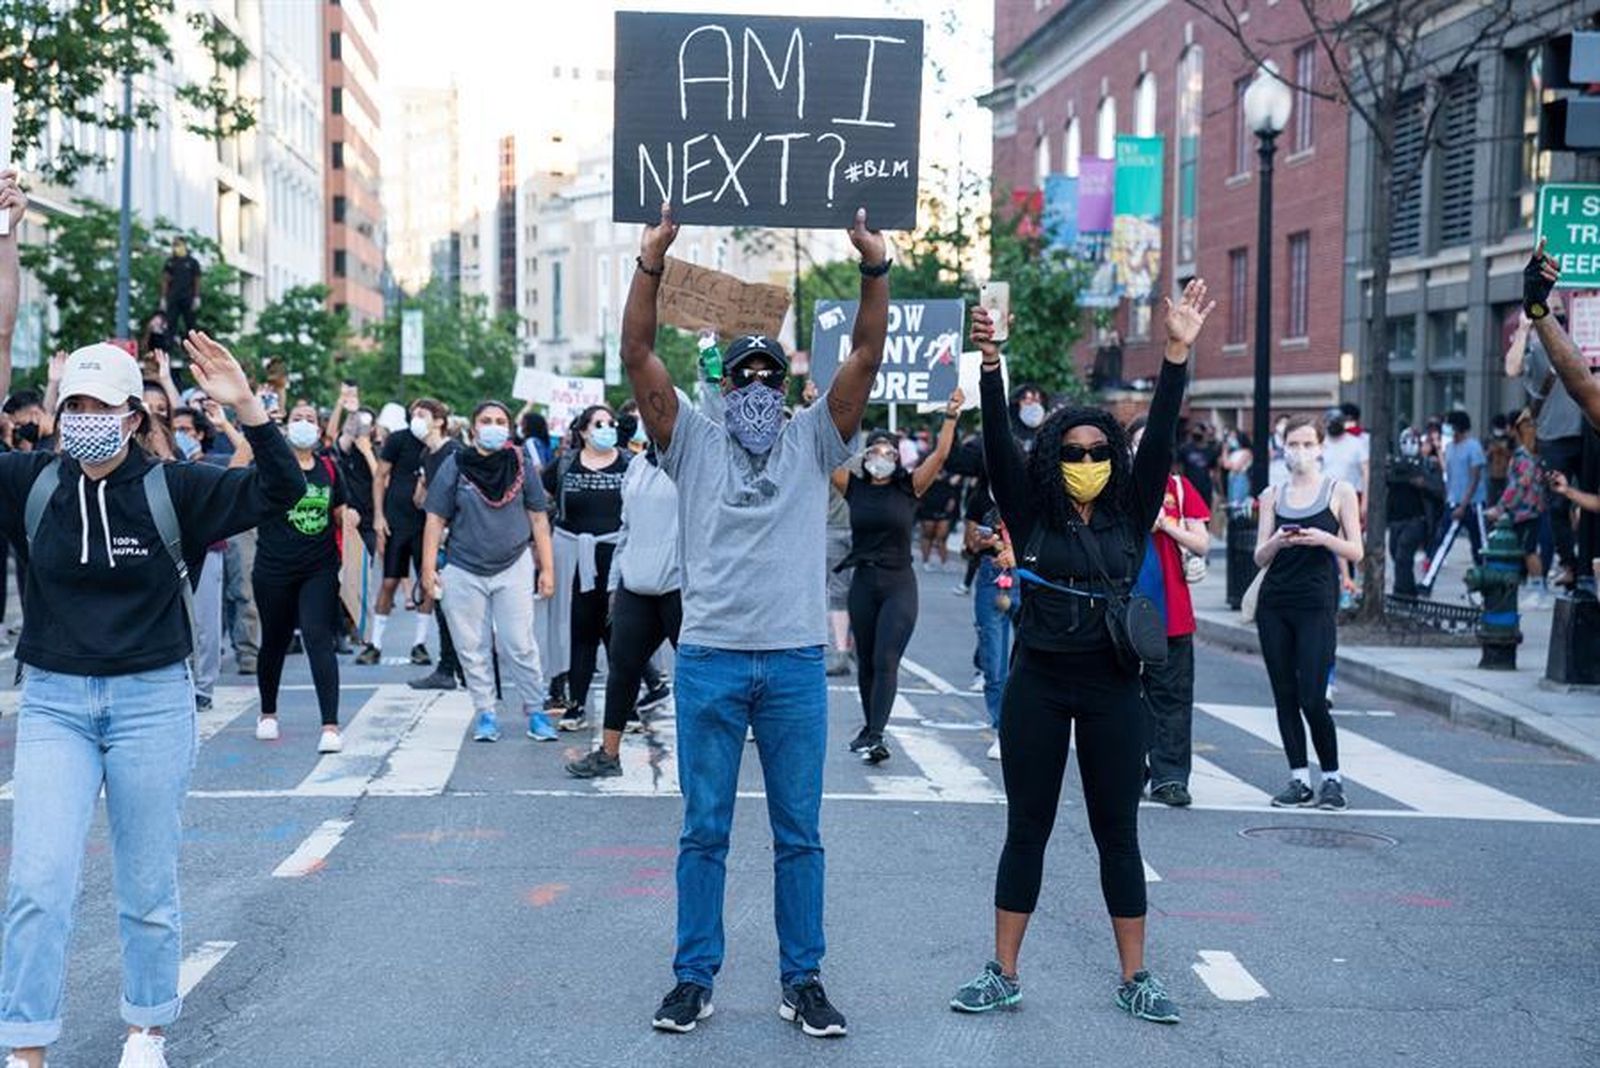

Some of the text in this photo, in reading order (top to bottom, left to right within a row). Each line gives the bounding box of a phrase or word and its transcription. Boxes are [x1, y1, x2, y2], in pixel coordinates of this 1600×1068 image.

[679, 24, 906, 127] AM I
[638, 132, 846, 208] NEXT?
[844, 159, 909, 183] #BLM
[1551, 196, 1569, 215] H
[1566, 224, 1600, 244] TR
[1556, 253, 1600, 274] EEP
[887, 304, 925, 332] OW
[746, 335, 767, 348] X
[838, 334, 924, 364] MNY
[869, 371, 930, 400] ORE
[112, 547, 148, 556] HUMAN
[113, 537, 139, 546] 100%
